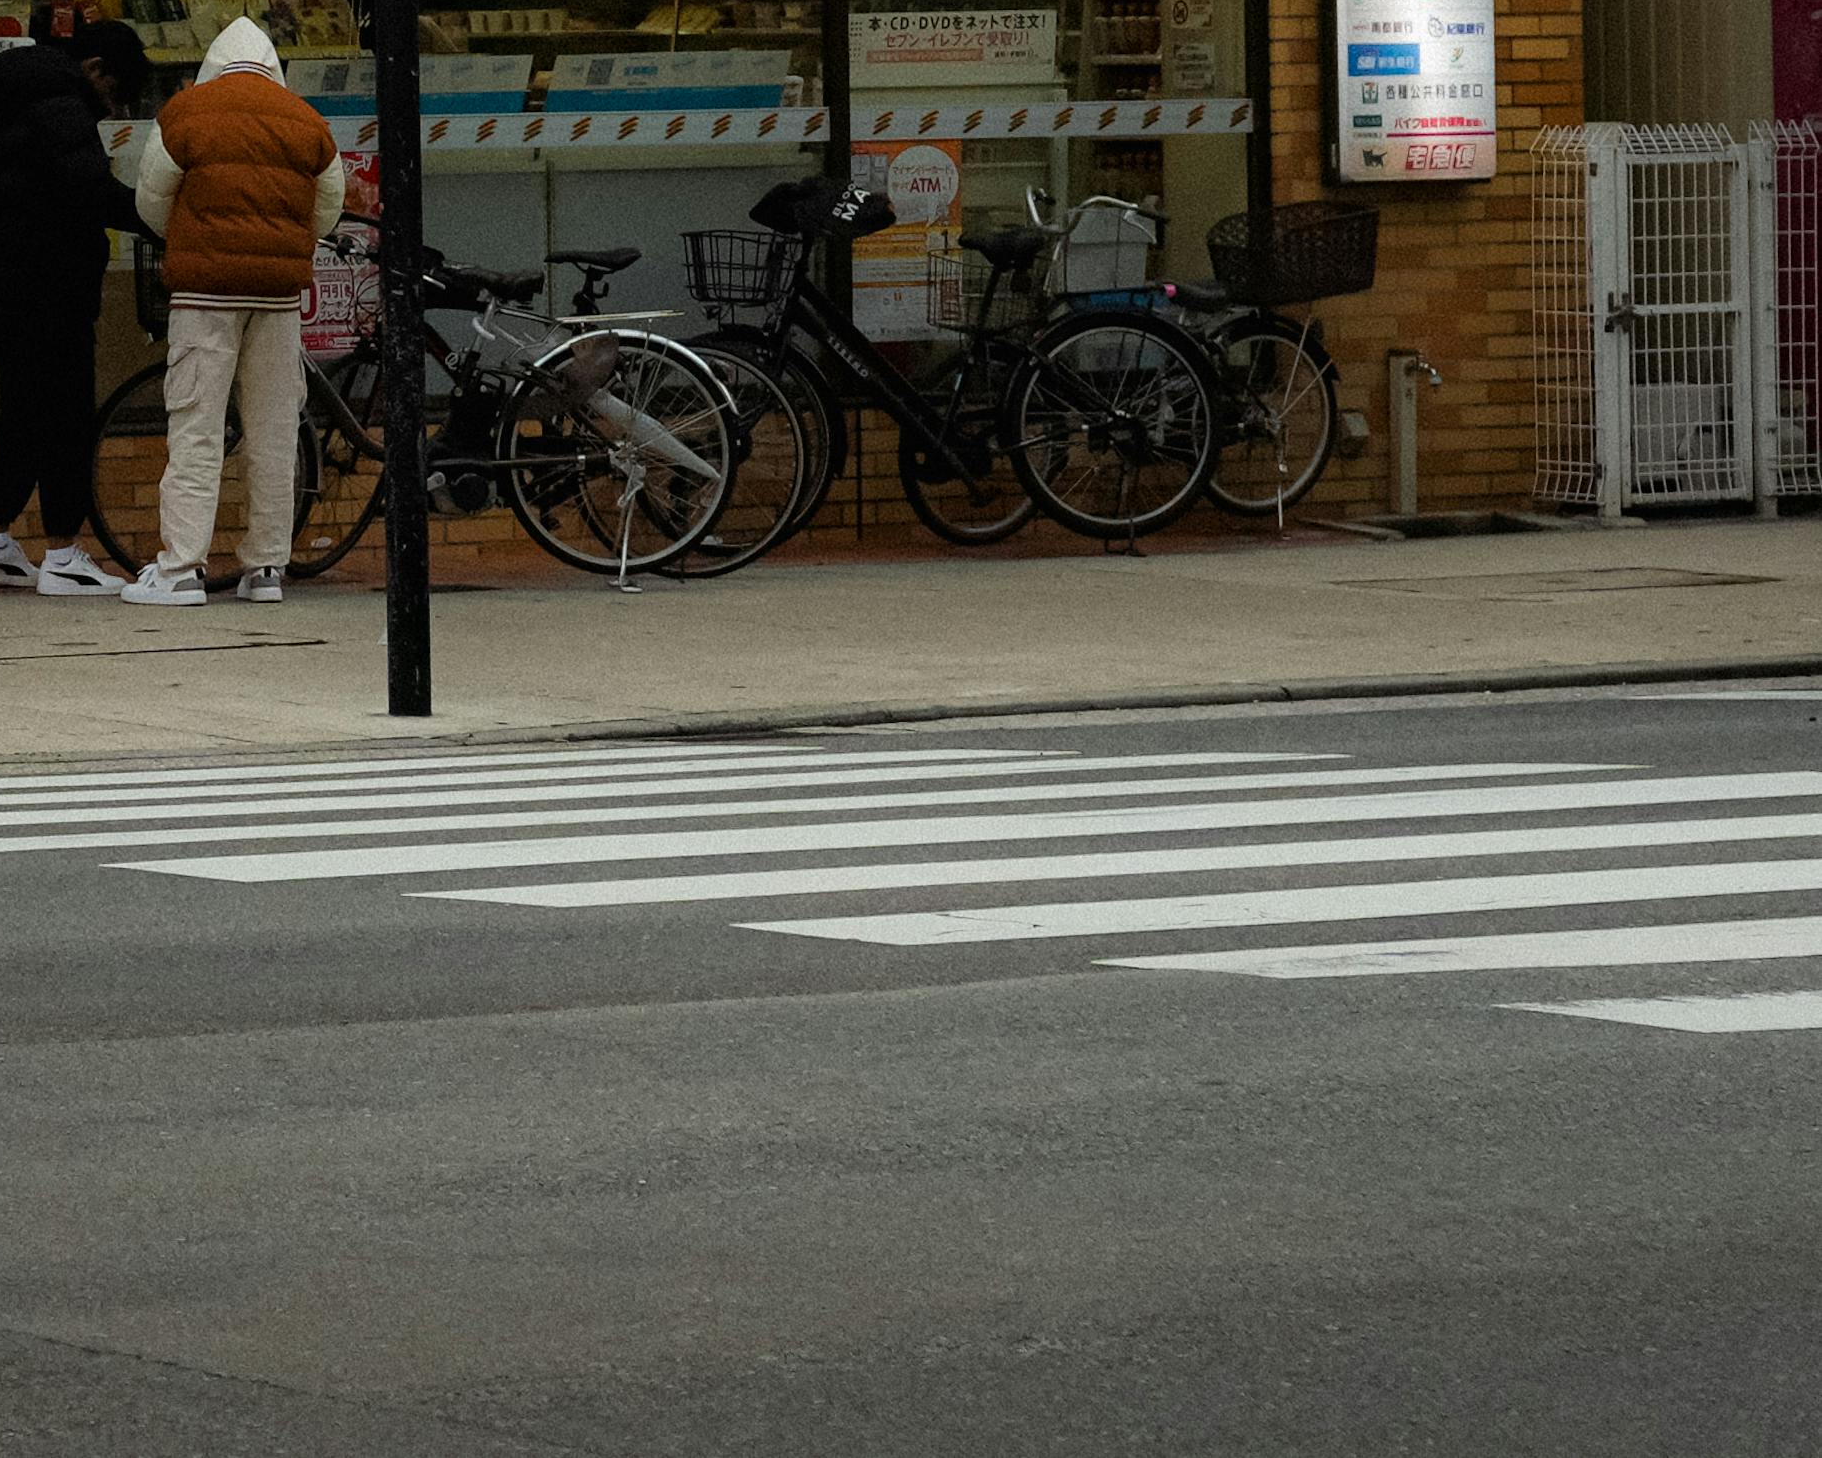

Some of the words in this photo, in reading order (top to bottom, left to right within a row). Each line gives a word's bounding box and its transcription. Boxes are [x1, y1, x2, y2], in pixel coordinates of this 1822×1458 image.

[1386, 84, 1483, 100] 各種公共料金窓口
[1406, 144, 1476, 170] 宅急便
[910, 177, 941, 193] ATM
